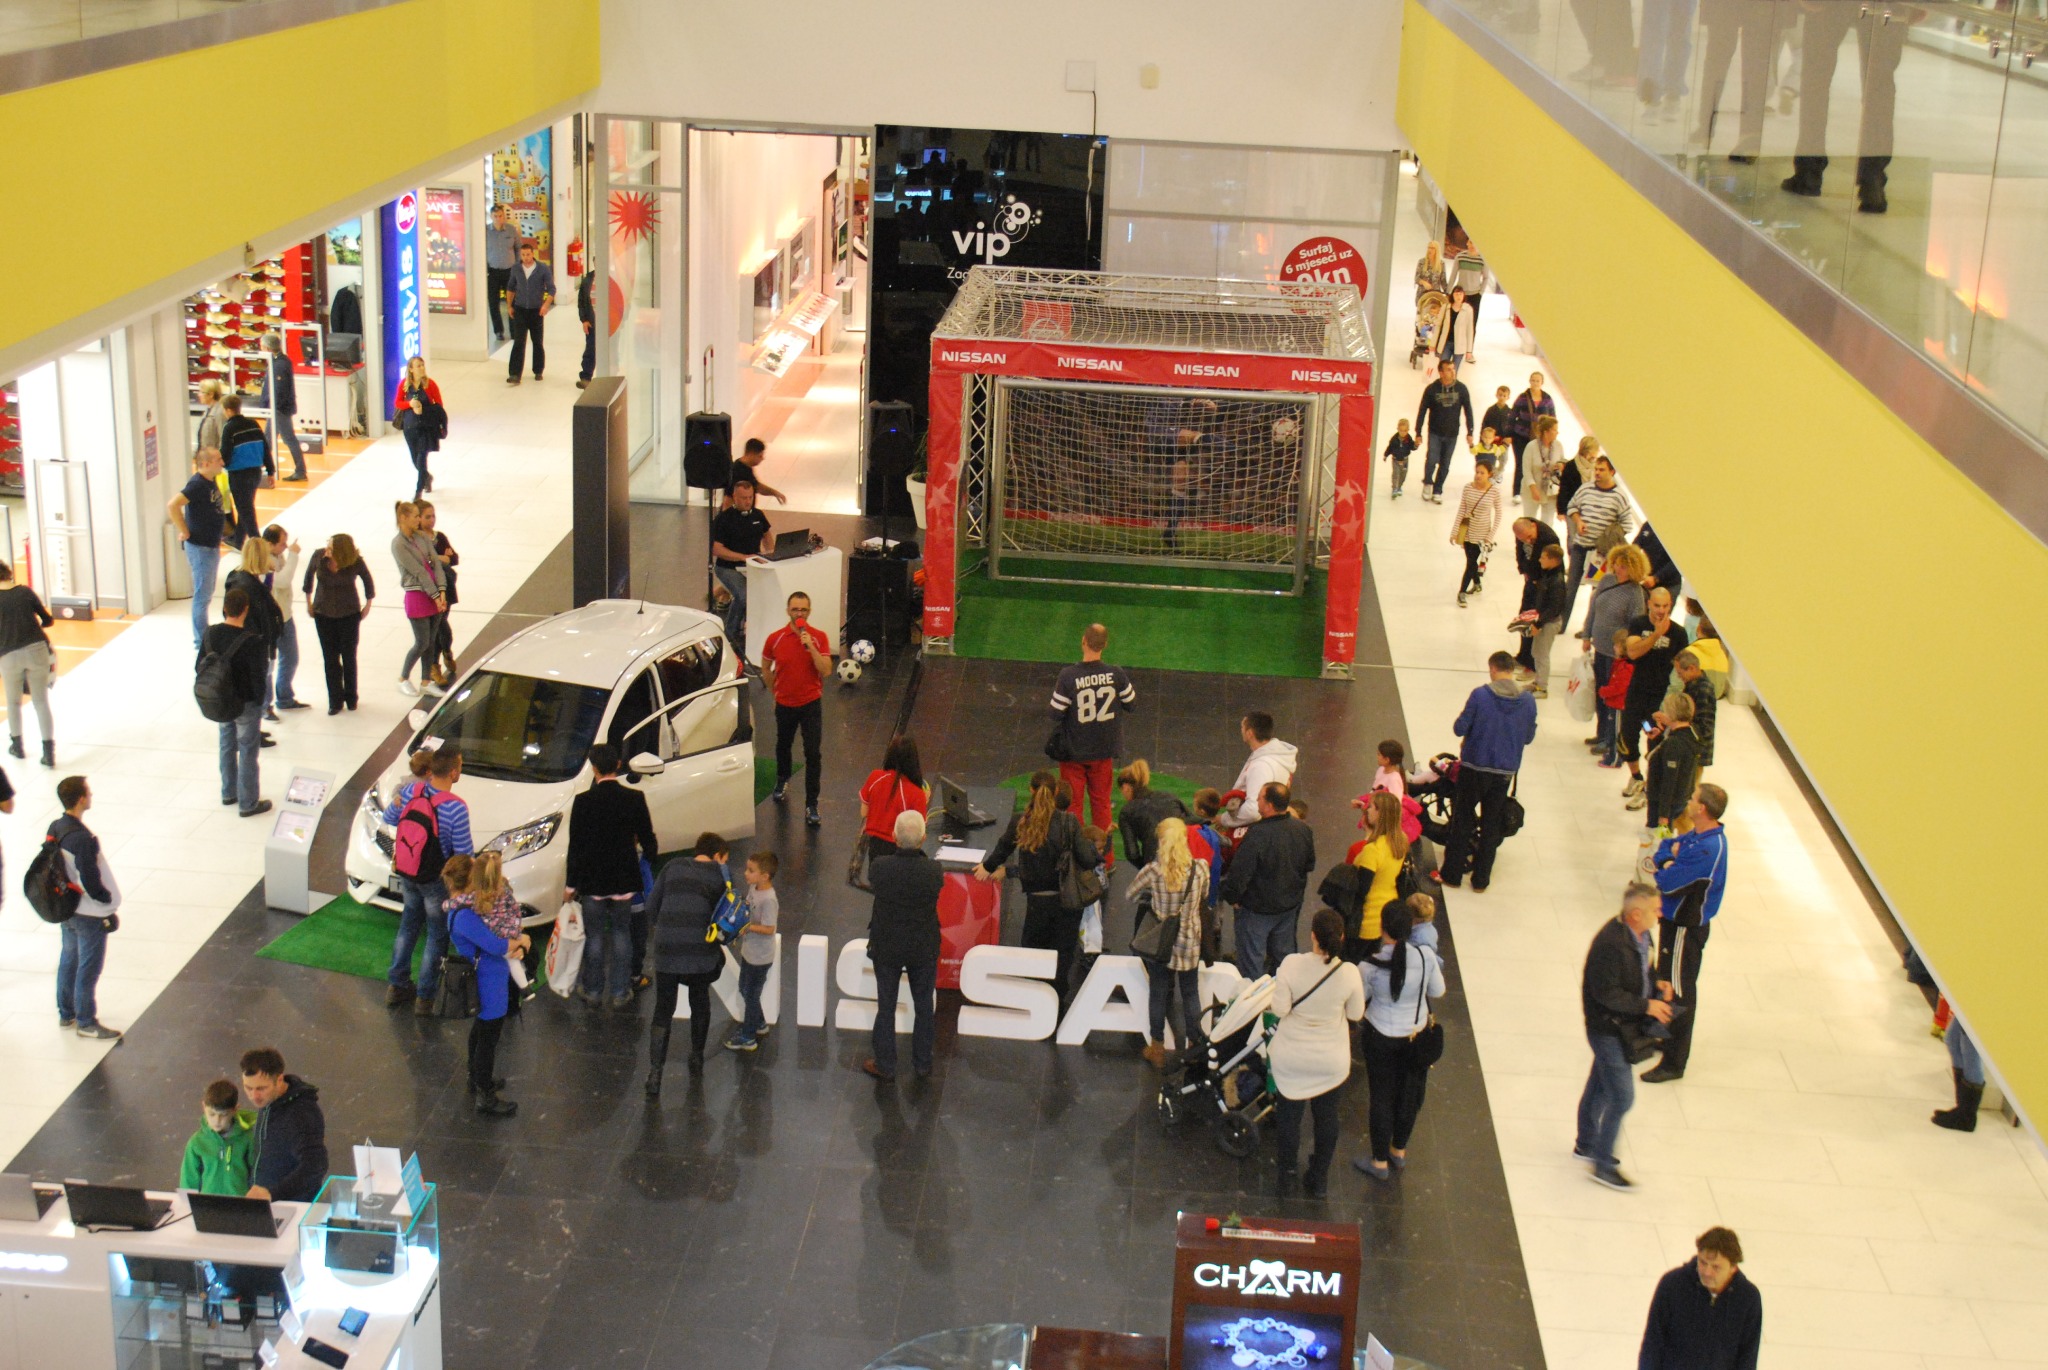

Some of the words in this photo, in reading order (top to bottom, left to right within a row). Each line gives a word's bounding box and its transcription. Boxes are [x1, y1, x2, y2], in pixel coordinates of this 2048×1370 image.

[952, 221, 1011, 265] vip
[1299, 242, 1333, 259] Surfaj
[1285, 265, 1294, 274] 6
[1296, 253, 1338, 272] mjeseci
[1339, 249, 1353, 259] uz
[941, 351, 1007, 364] NISSAN
[1057, 357, 1123, 371] NISSAN
[1173, 364, 1240, 378] NISSAN
[1291, 370, 1358, 384] NISSAN
[1075, 673, 1114, 689] MOORE
[1076, 685, 1116, 723] 82
[1193, 1259, 1342, 1298] CHARM
